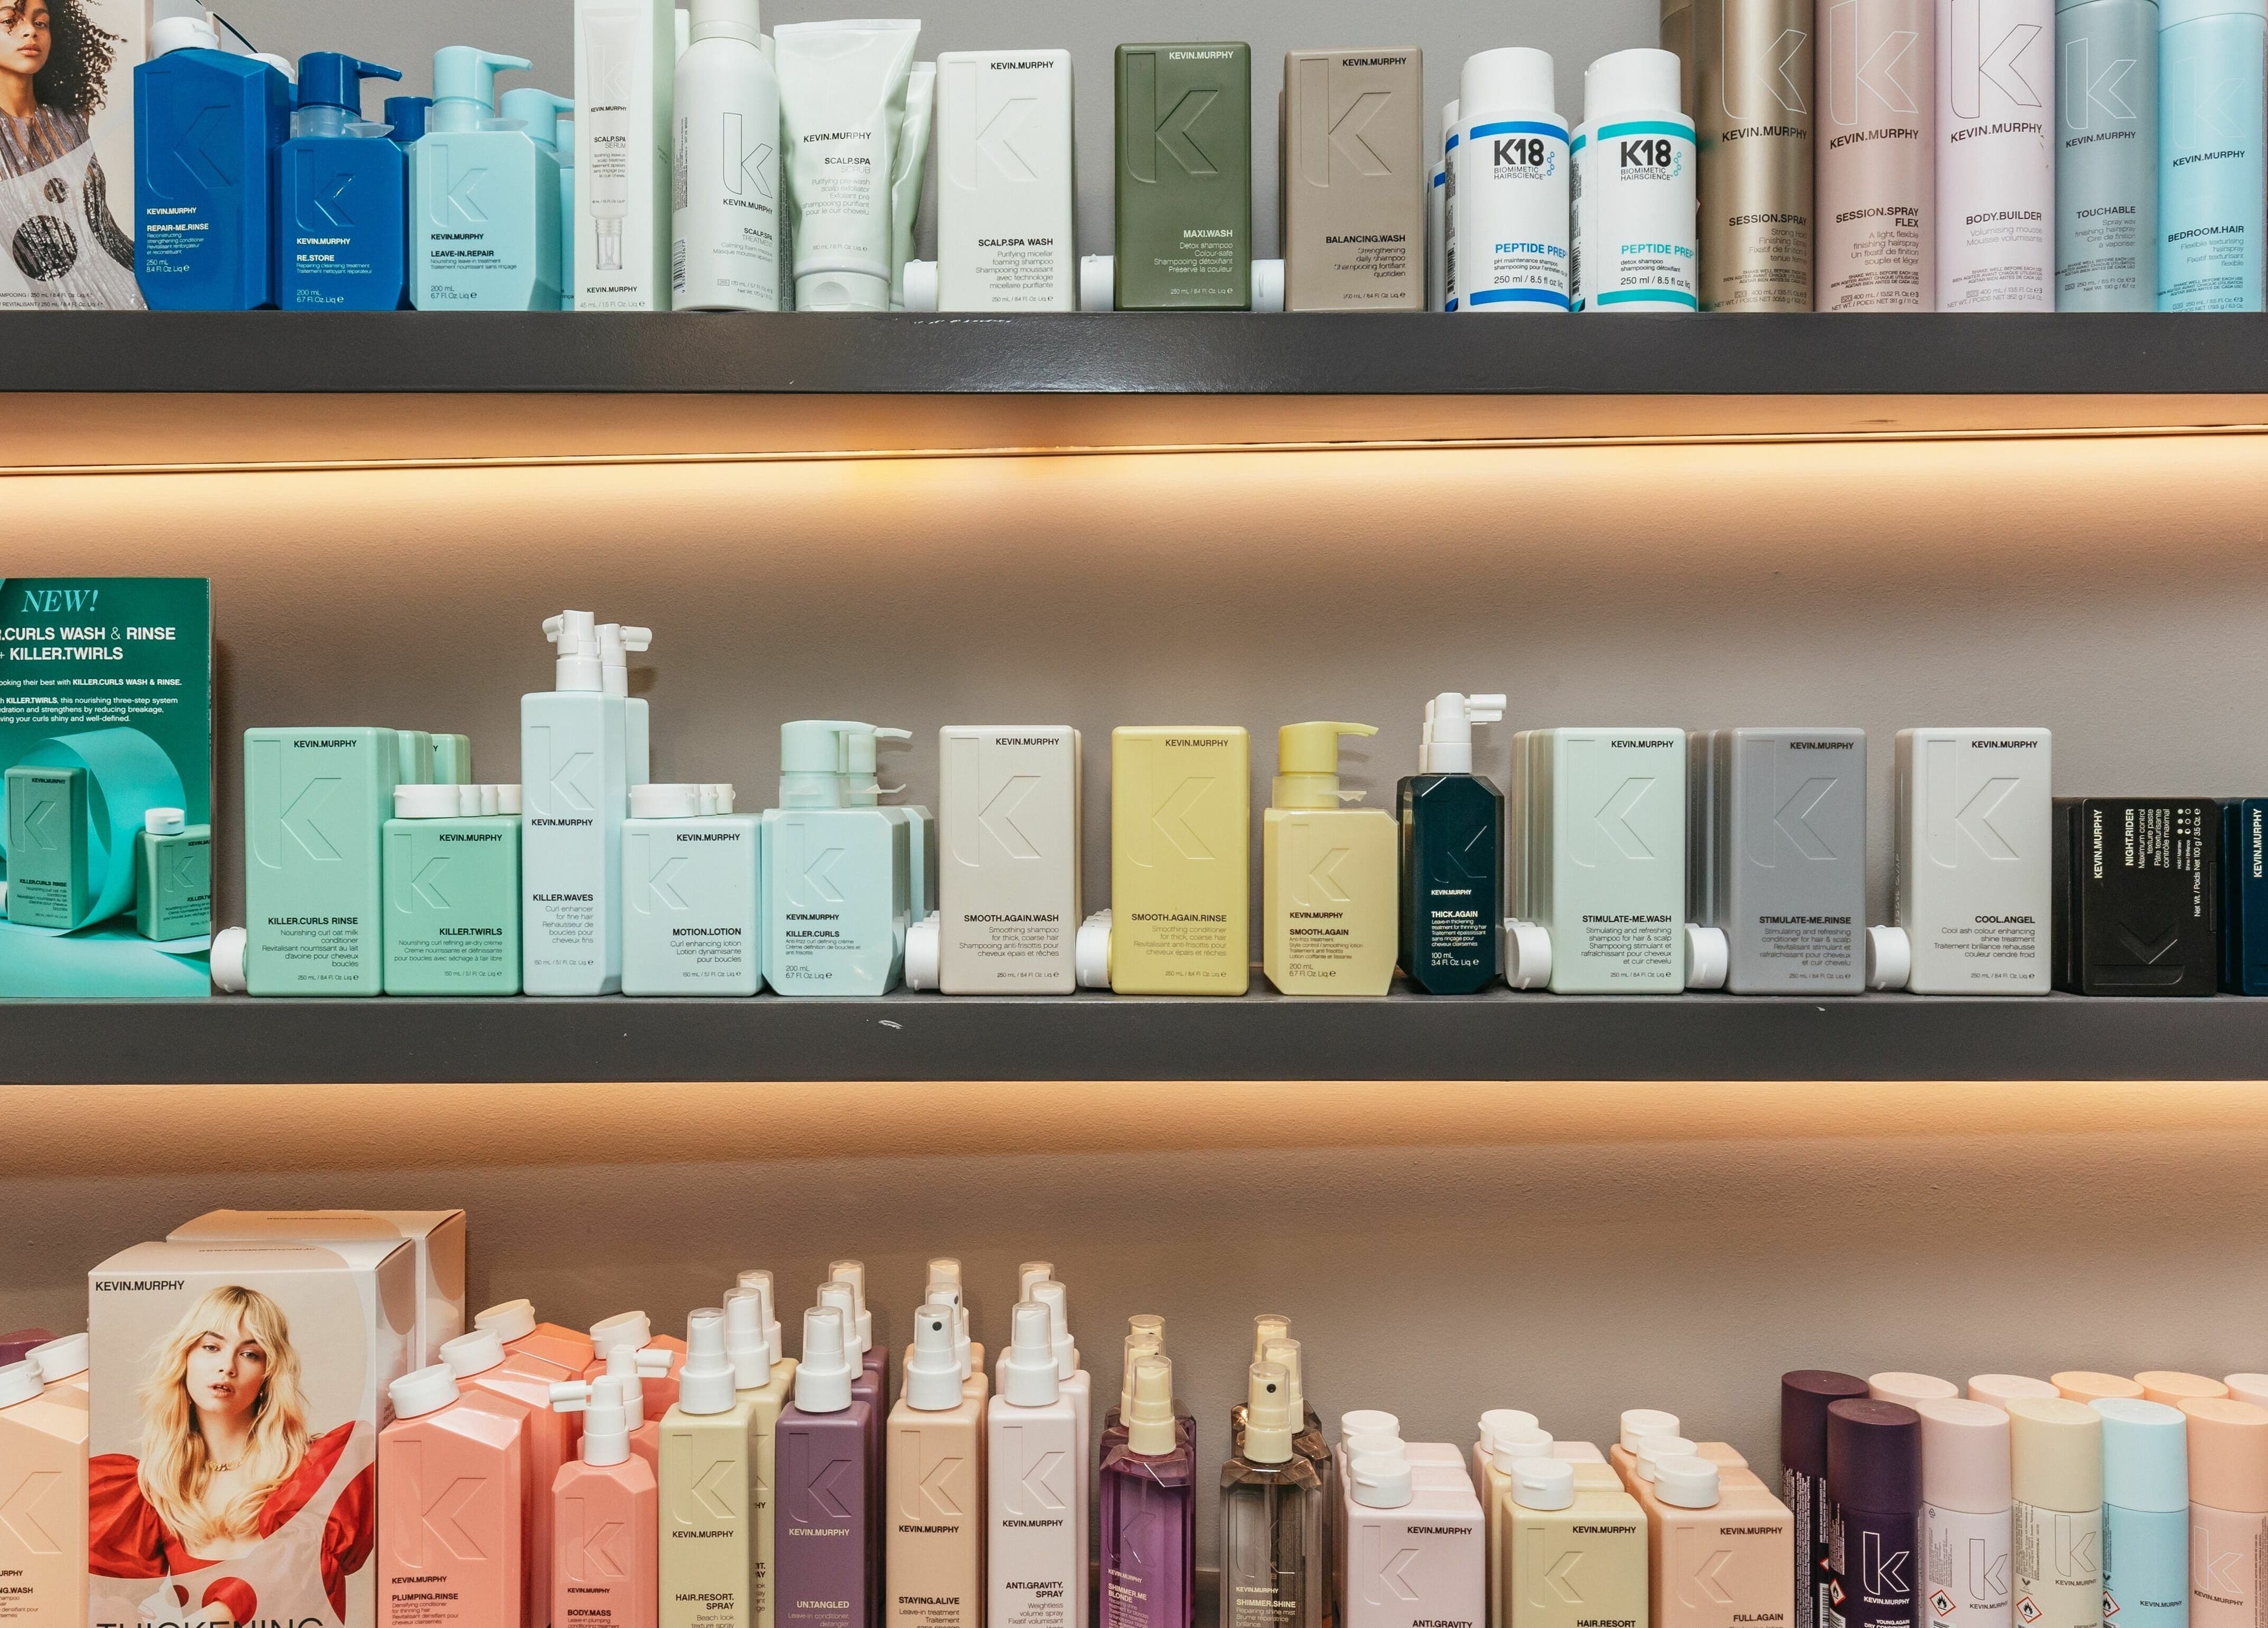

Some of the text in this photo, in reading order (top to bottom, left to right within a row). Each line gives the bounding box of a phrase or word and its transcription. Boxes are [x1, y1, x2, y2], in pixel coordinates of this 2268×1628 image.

[1169, 50, 1233, 59] KEVIN.MURPHY
[1343, 58, 1406, 66] KEVIN.MURPHY
[804, 132, 871, 142] KEVIN.MURPHY
[1723, 126, 1806, 142] KEVIN.MURPHY
[1830, 129, 1918, 149] KEVIN.MURPHY
[1951, 123, 2043, 143] KEVIN.MURPHY
[2066, 132, 2136, 148] KEVIN.MURPHY
[1494, 139, 1544, 167] K18
[1621, 139, 1671, 168] K18
[2174, 151, 2244, 167] KEVIN.MURPHY
[840, 164, 871, 174] SCRUB
[724, 198, 772, 214] KEVIN.MURPHY
[2077, 206, 2135, 219] TOUCHABLE
[1729, 214, 1805, 226] SESSION.SPRAY
[1836, 207, 1918, 224] SESSION.SPRAY
[1967, 211, 2041, 224] BODY.BUILDER
[147, 223, 208, 232] REPAIR-ME.RINSE
[1896, 218, 1918, 227] FLEX
[2169, 226, 2244, 243] BEDROOM.HAIR
[997, 250, 1025, 259] Purifying
[1495, 243, 1565, 258] PEPTIDE PREP
[1622, 244, 1692, 258] PEPTIDE PREP
[1621, 277, 1637, 285] 250
[1651, 276, 1655, 285] /
[1657, 276, 1669, 285] 8.5
[21, 590, 98, 612] NEW!
[0, 627, 175, 640] .CURLS WASH & RINSE
[10, 647, 123, 660] KILLER.TWIRLS
[2094, 810, 2103, 878] KEVIN.MURPHY
[2253, 809, 2262, 877] KEVIN.MURPHY
[989, 927, 1059, 935] Smoothing shampoo
[686, 940, 721, 949] enhancing
[724, 940, 741, 949] lotion
[96, 1281, 184, 1291] KEVIN.MURPHY
[1006, 1581, 1063, 1590] ANTI.GRAVITY.
[392, 1593, 458, 1601] PLUMPING.RINSE
[676, 1593, 735, 1601] HAIR.RESORT.
[1236, 1598, 1296, 1608] SHIMMER.SHINE
[1864, 1596, 1909, 1605] KEVIN.MURPHY
[2195, 1590, 2243, 1606] KEVIN.MURPHY
